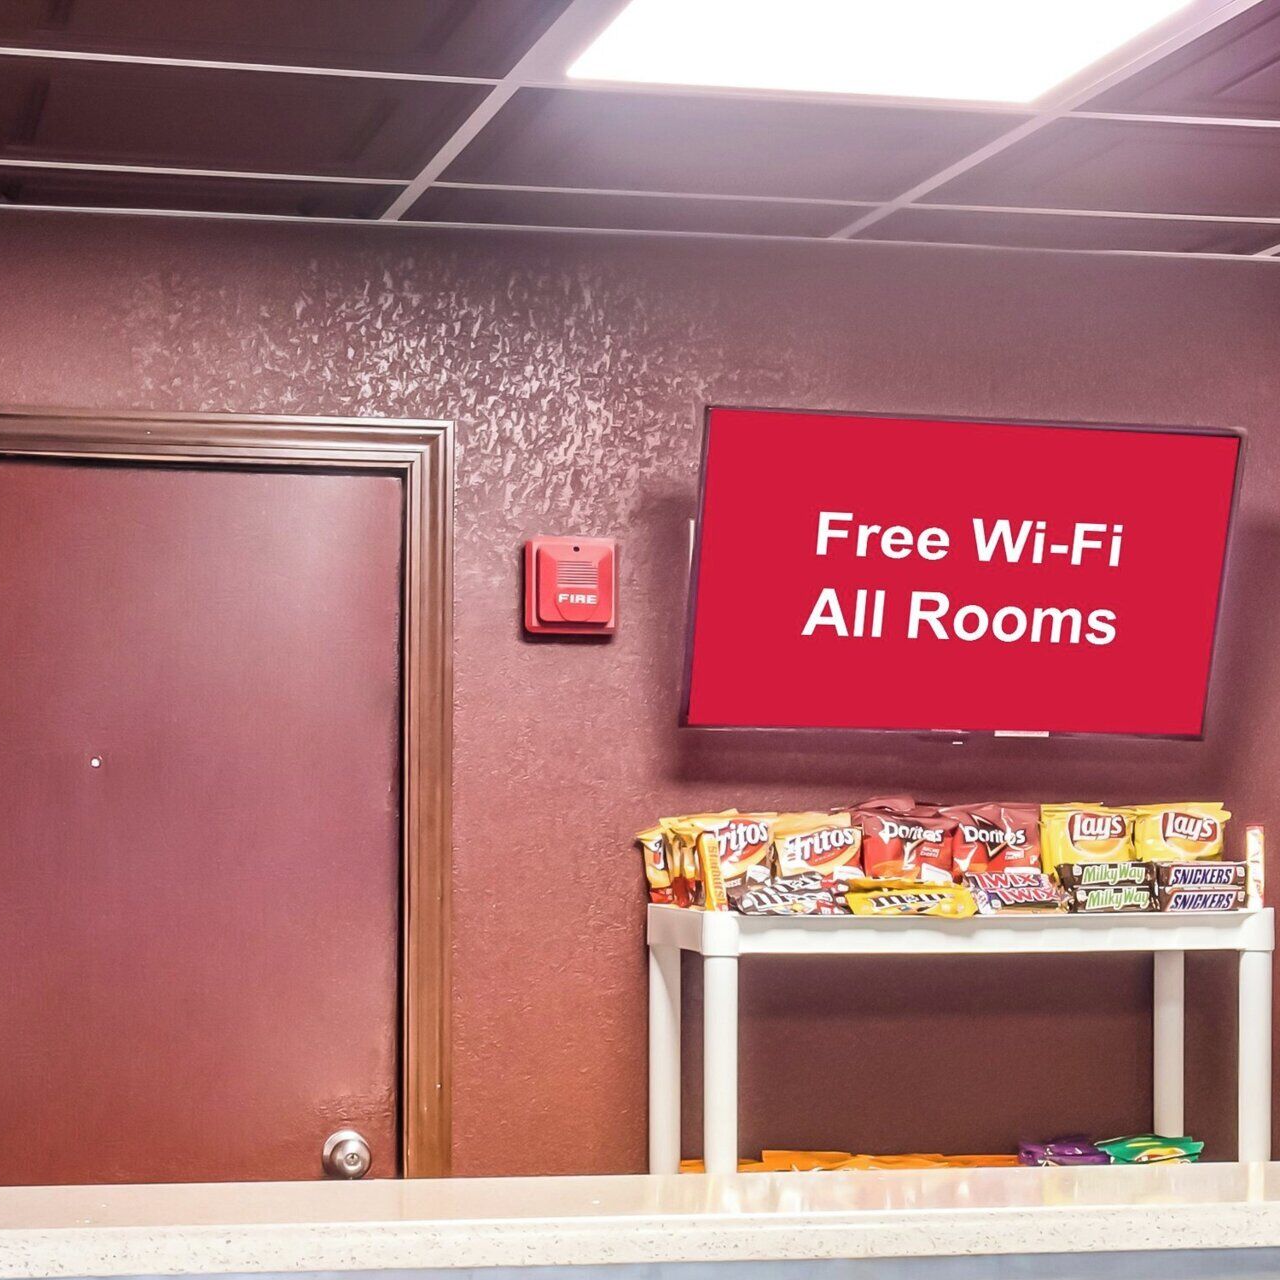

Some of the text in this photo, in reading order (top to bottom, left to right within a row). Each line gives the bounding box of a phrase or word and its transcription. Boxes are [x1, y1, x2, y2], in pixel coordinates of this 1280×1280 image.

[817, 512, 1123, 566] Free Wi-Fi
[558, 593, 597, 605] FIRE
[802, 588, 1116, 644] All Rooms
[790, 827, 855, 860] Fritos
[1082, 863, 1146, 884] Milky Way
[1171, 867, 1234, 885] SNICKERS
[1086, 888, 1150, 910] Milky Way
[1170, 891, 1234, 910] SNICKERS
